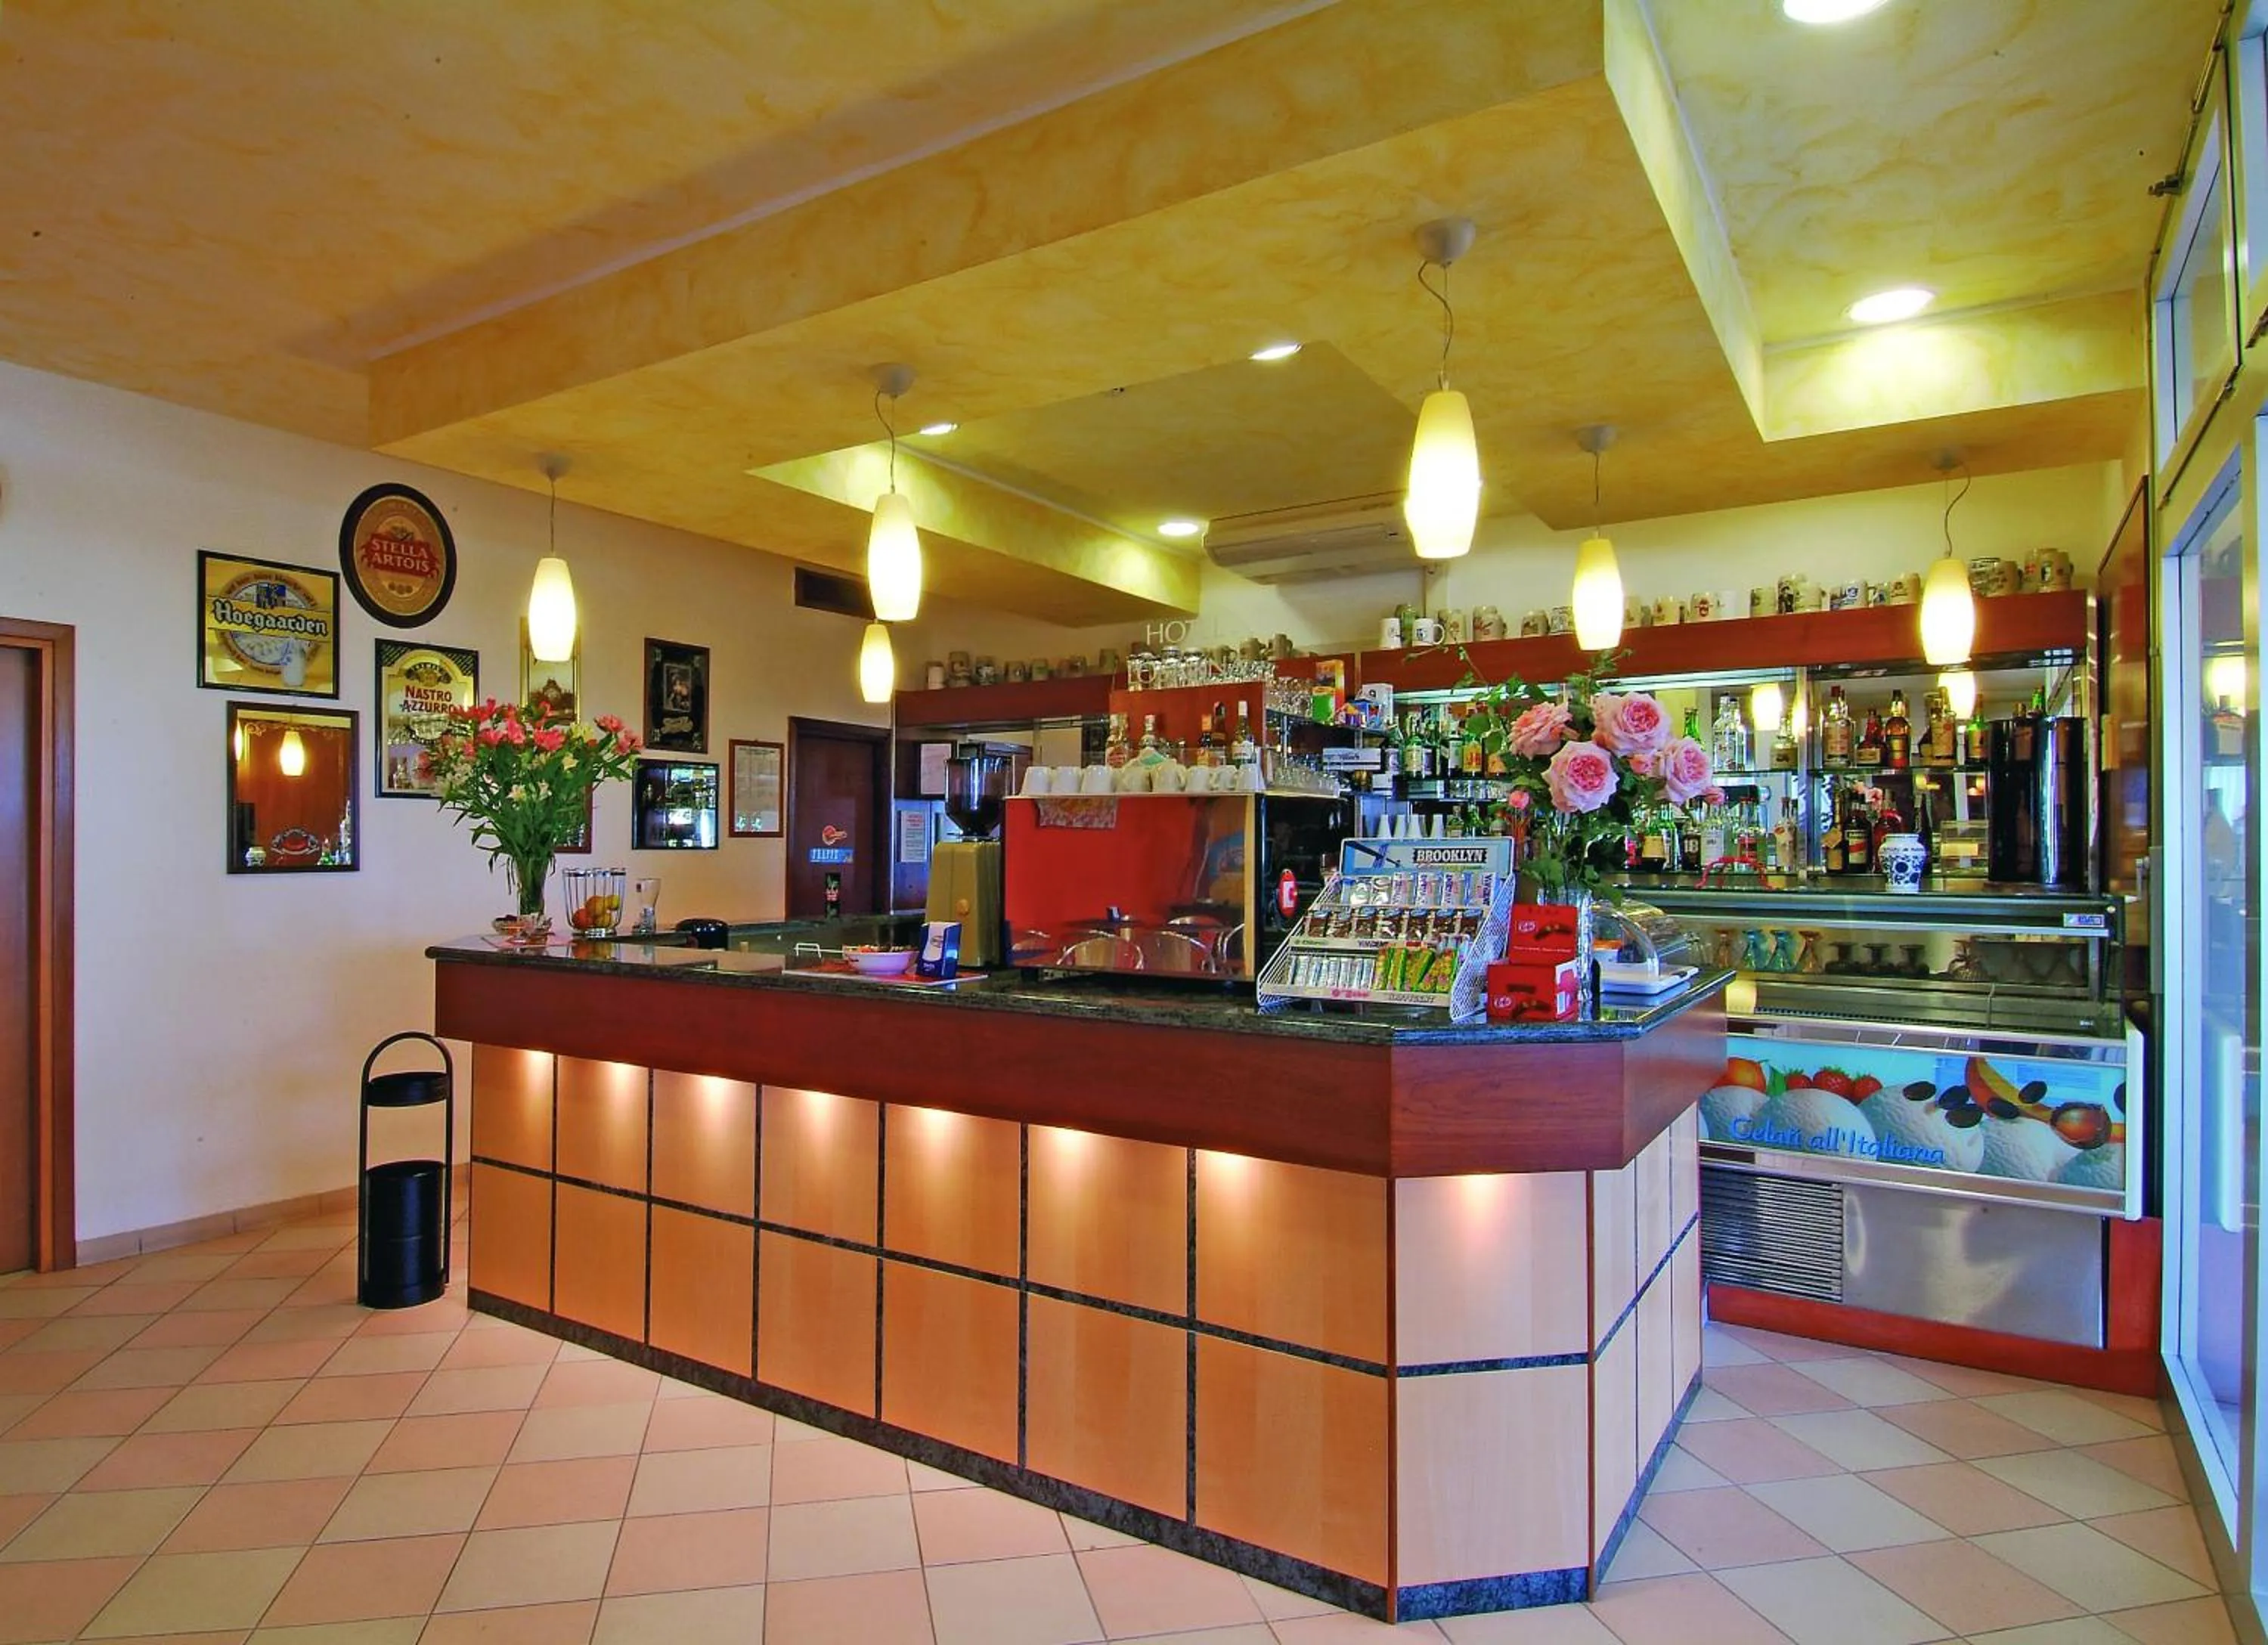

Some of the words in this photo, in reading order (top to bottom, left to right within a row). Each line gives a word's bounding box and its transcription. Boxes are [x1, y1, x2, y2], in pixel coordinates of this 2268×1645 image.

[371, 537, 429, 559] STELLA
[373, 552, 430, 573] ARTOIS
[213, 598, 328, 637] Hoegaarden
[404, 684, 452, 702] NASTRO
[1416, 849, 1484, 863] BROOKLYN
